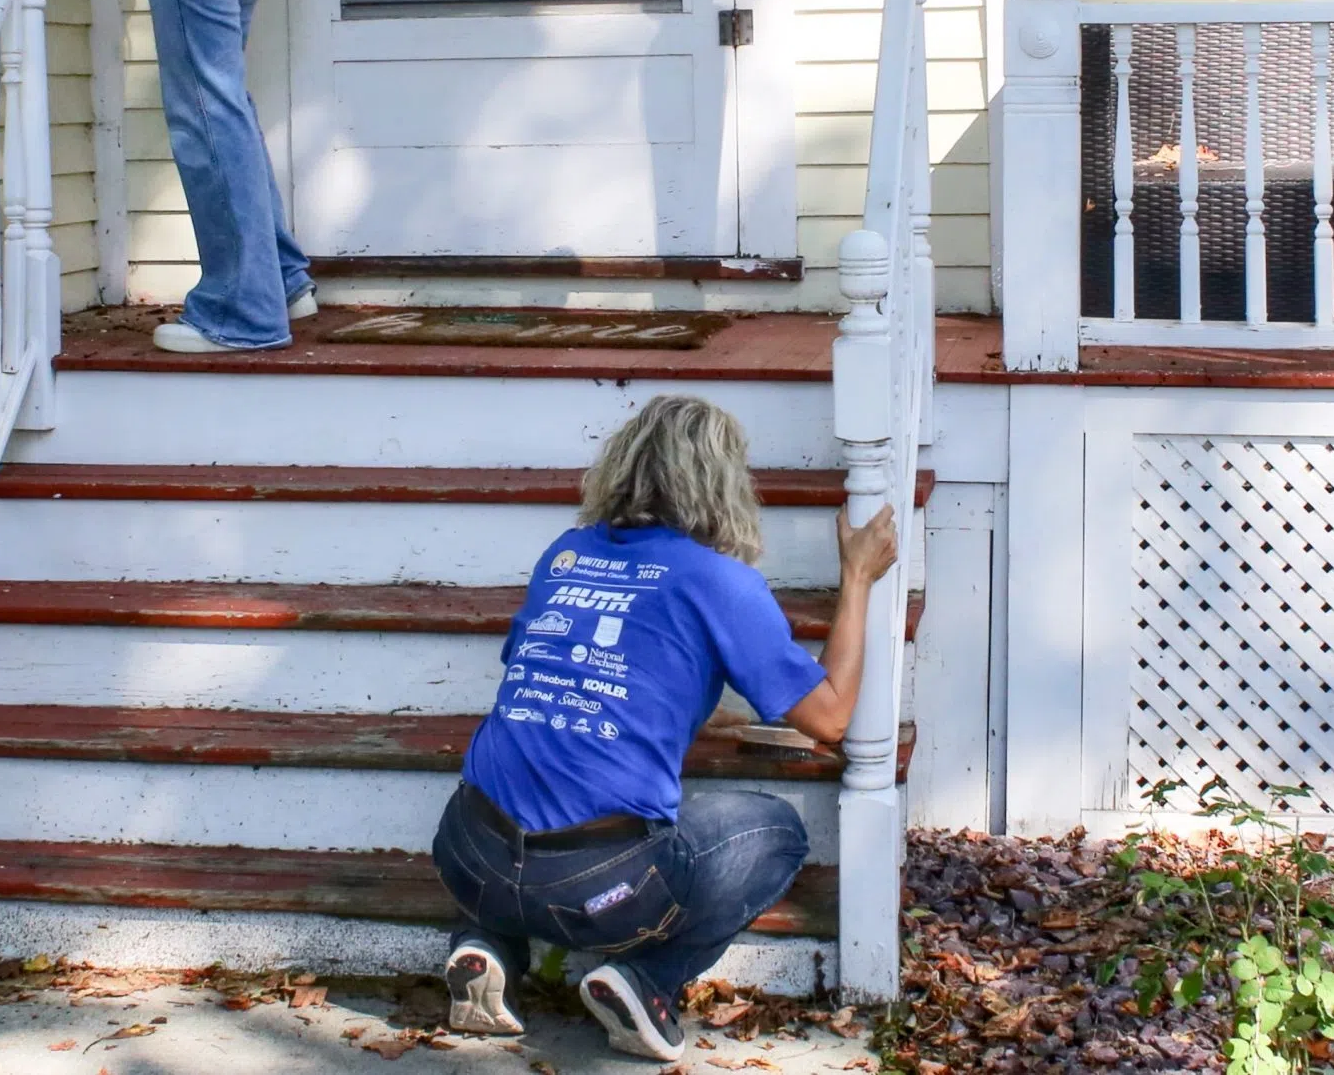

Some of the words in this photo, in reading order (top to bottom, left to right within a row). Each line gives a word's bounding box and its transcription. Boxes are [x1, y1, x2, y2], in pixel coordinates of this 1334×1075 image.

[576, 555, 609, 569] UNITED
[608, 560, 628, 572] WAY
[636, 570, 662, 579] 2025
[546, 585, 637, 613] MUTH
[587, 647, 625, 663] National
[587, 656, 629, 673] Exchange
[582, 678, 628, 700] KOHLER
[522, 687, 556, 703] Nemak
[558, 695, 602, 711] SARGENTO
